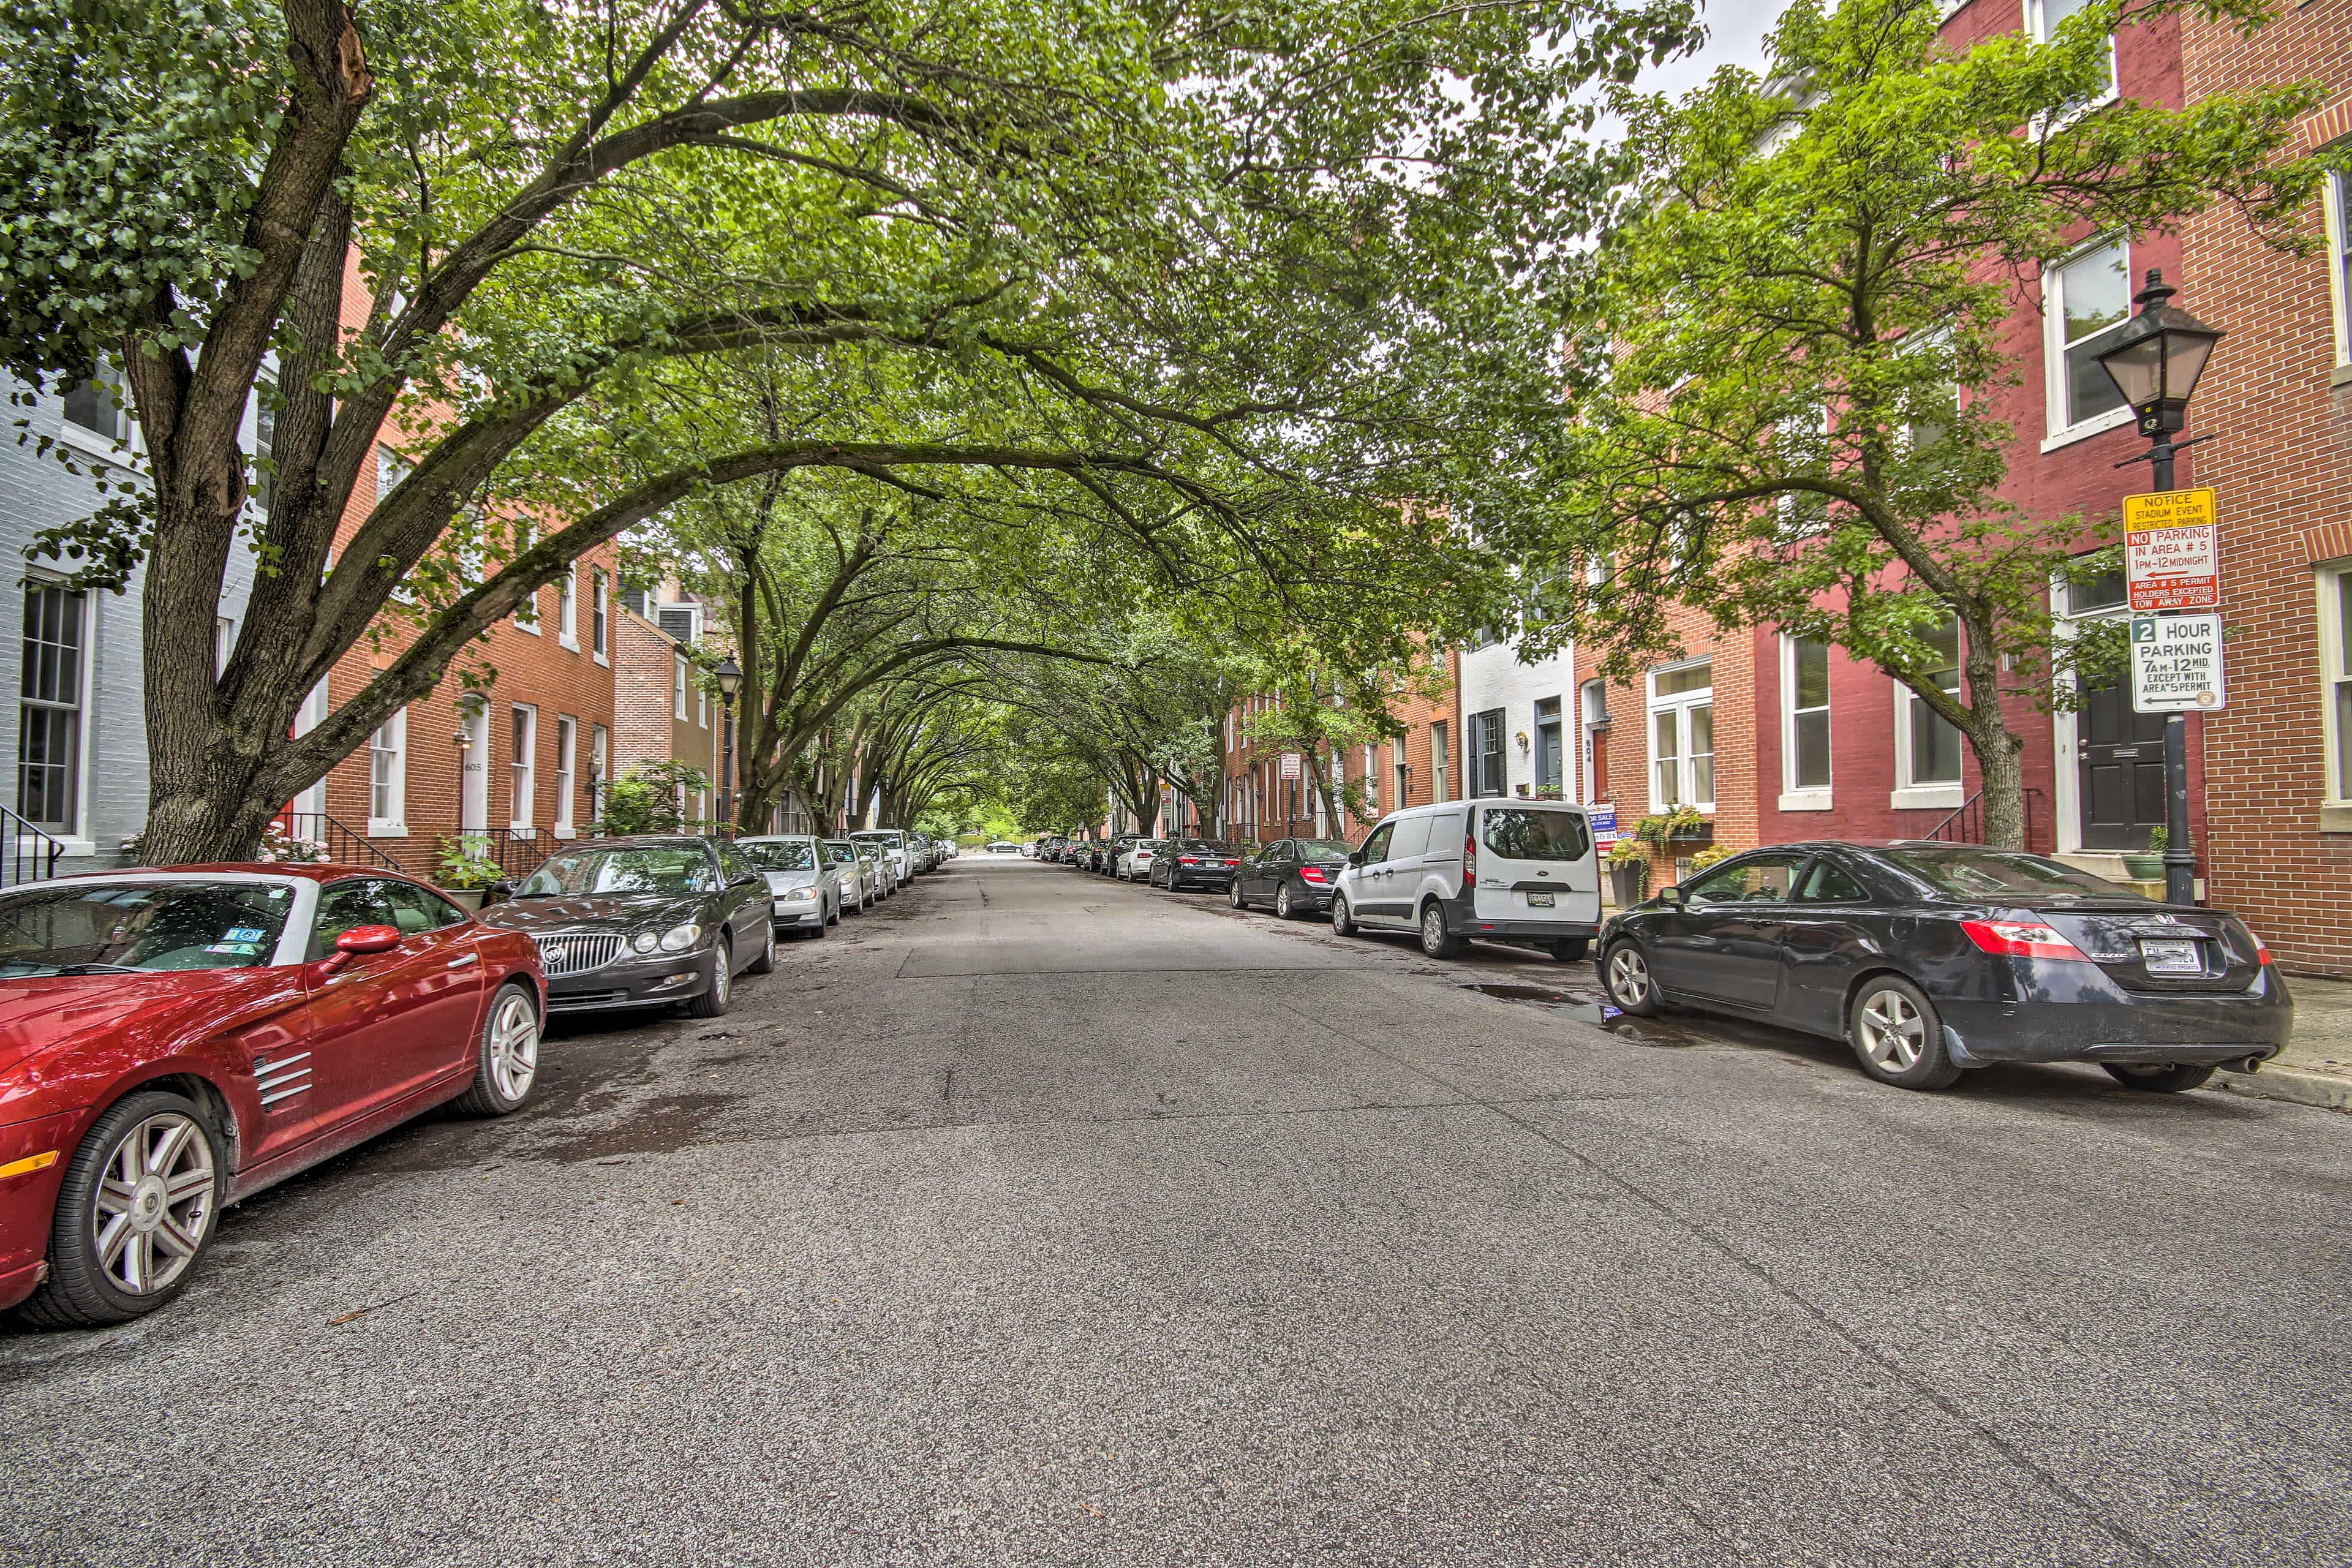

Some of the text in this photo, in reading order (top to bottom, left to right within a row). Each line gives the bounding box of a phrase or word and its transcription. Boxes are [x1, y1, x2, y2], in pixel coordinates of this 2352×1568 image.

[2145, 494, 2193, 507] NOTICE
[2136, 505, 2203, 519] STADIUM EVENT
[2133, 516, 2207, 530] RESTRICTED PARKING
[2131, 527, 2209, 545] NO PARKING
[2135, 541, 2206, 556] IN AREA # 5
[2170, 556, 2208, 567] MIDNIGHT
[2180, 577, 2211, 586] PERMIT
[2133, 586, 2213, 598] HOLDERS EXCEPTED
[2135, 595, 2214, 608] TOW AWAY ZONE
[2139, 622, 2211, 641] 2 HOUR
[2141, 643, 2212, 657] PARKING
[2147, 672, 2206, 683] EXCEPT WITH
[2180, 682, 2211, 692] PERMIT
